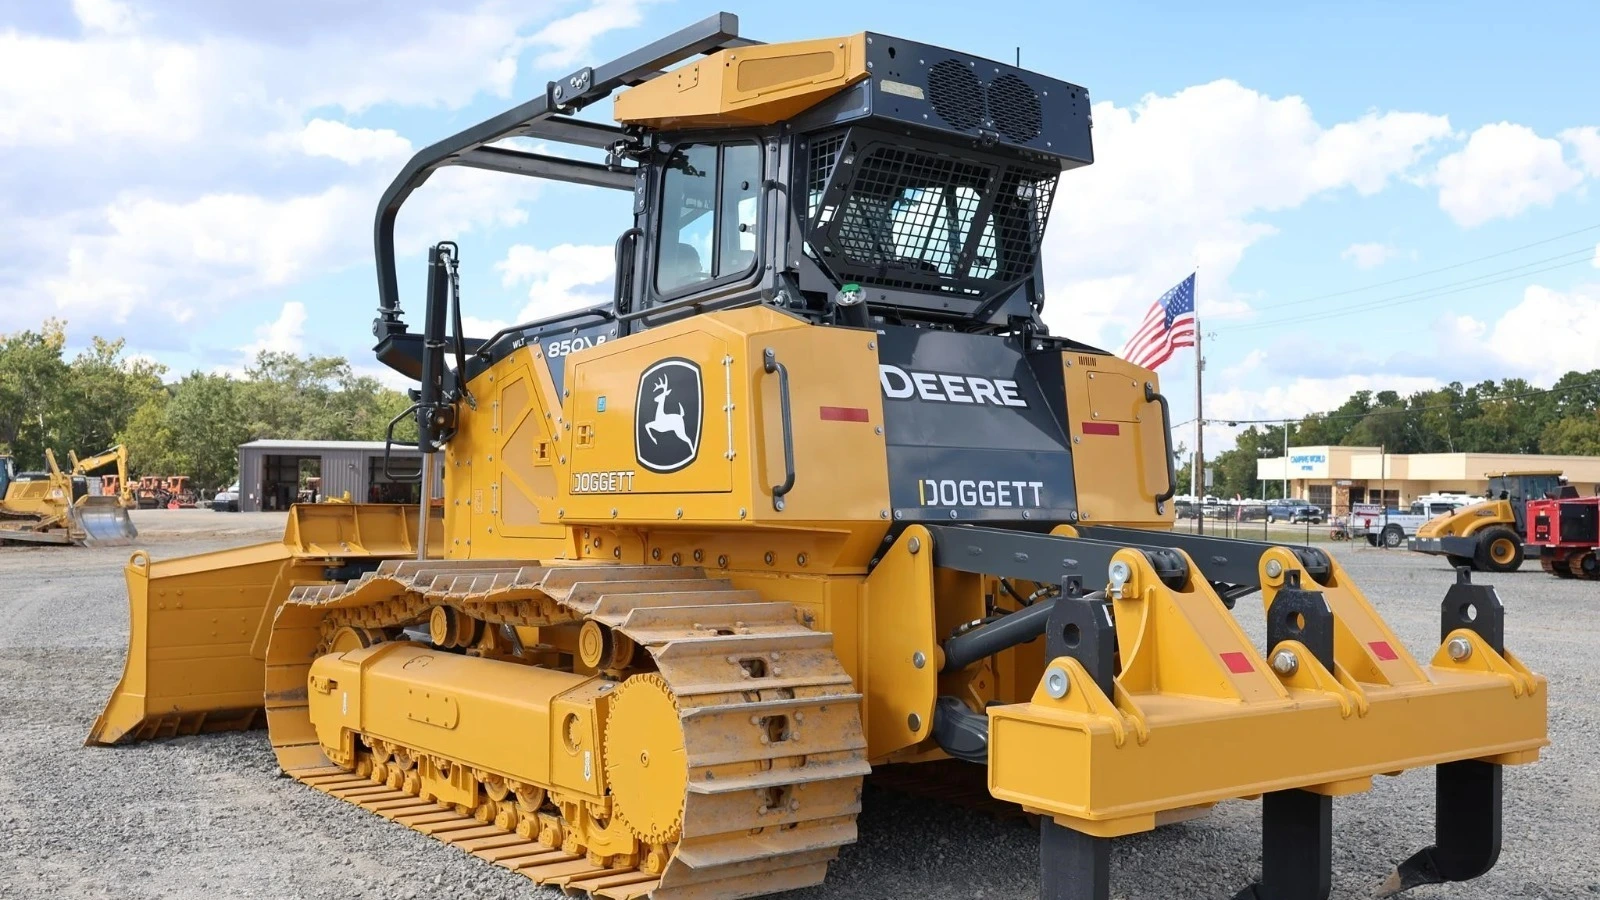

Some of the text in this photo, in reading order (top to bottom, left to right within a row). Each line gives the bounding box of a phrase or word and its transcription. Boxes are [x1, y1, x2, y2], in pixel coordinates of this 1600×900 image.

[512, 337, 525, 349] WLT
[878, 364, 1027, 407] DEERE
[572, 471, 635, 492] DOGGETT
[918, 479, 1043, 507] DOGGETT
